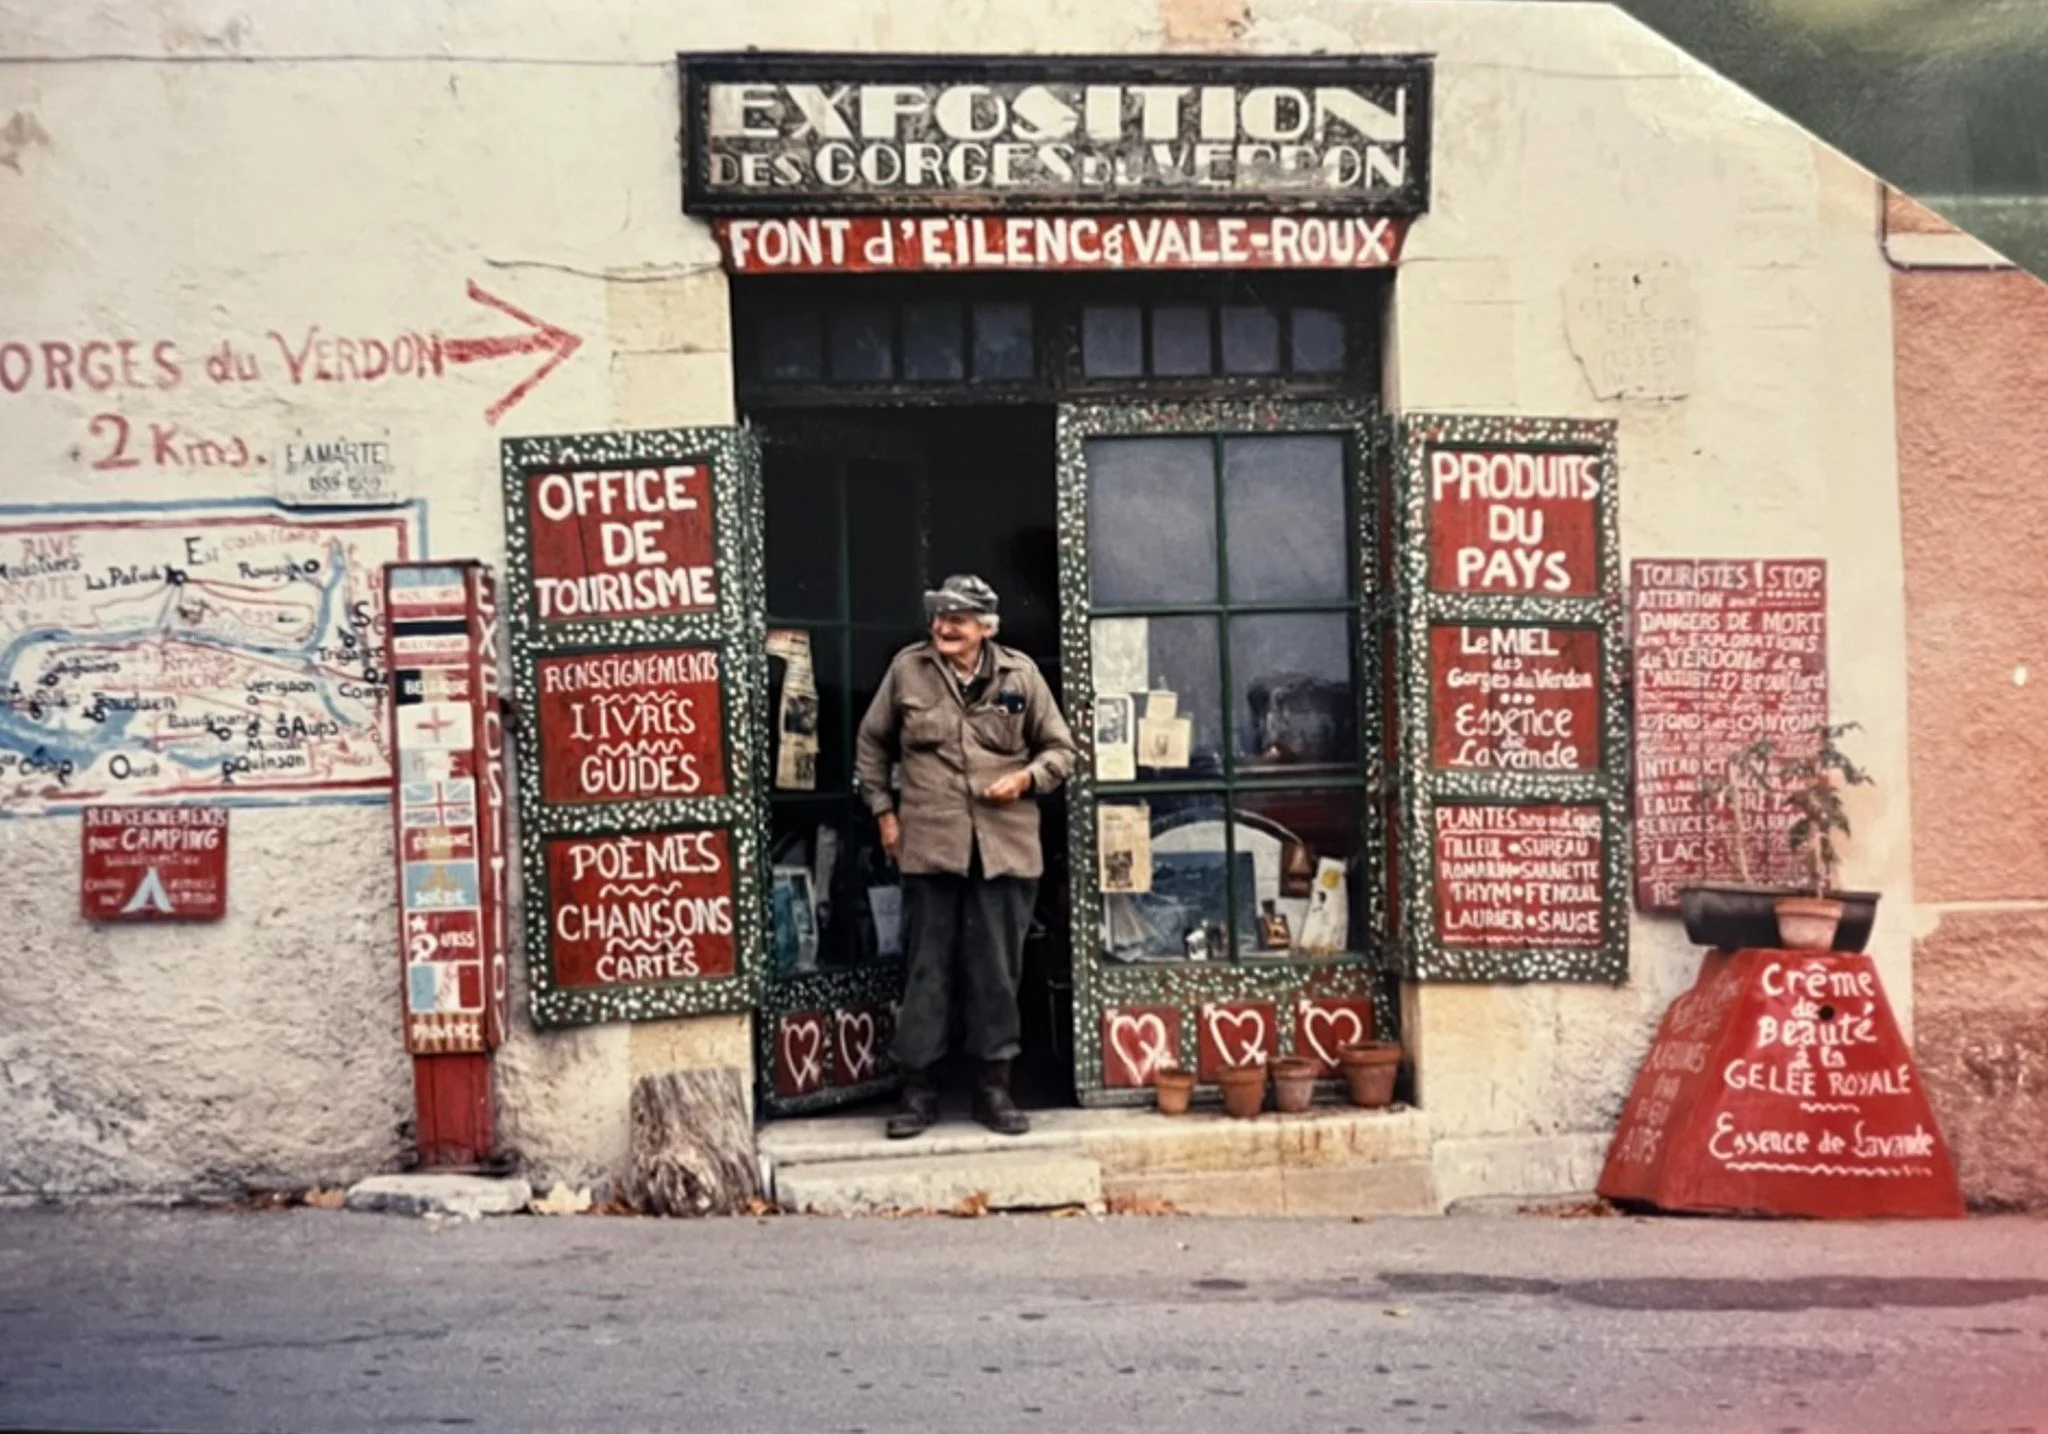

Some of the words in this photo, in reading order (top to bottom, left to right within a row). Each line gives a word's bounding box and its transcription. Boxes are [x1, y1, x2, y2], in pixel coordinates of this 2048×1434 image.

[708, 83, 1405, 142] EXPOSITION
[709, 153, 802, 187] DES
[815, 142, 1074, 188] GORGES
[729, 218, 851, 267] FONT
[1127, 217, 1391, 264] VALE-ROUX
[206, 341, 260, 385] du
[268, 325, 446, 382] VERDON
[89, 412, 141, 470] 2
[538, 466, 698, 521] OFFICE
[1431, 452, 1601, 501] PRODUITS
[601, 520, 668, 566] DE
[1488, 504, 1544, 545] DU
[1457, 546, 1571, 592] PAYS
[1636, 558, 1749, 590] TOURISTES
[1767, 565, 1823, 589] STOP
[534, 566, 717, 618] TOURISME
[1460, 626, 1488, 655] Le
[1490, 627, 1561, 656] MIEL
[1640, 612, 1721, 633] DANGERS
[1726, 613, 1750, 632] DE
[1762, 612, 1825, 635] MORT
[544, 651, 719, 692] RENSEIGNEMENTS
[1446, 667, 1510, 694] Gorges
[1532, 667, 1594, 689] Verdon
[569, 698, 696, 741] LIVRES
[1454, 703, 1574, 738] Essence
[580, 753, 701, 794] GUIDES
[1448, 739, 1580, 770] Lavande
[1435, 807, 1518, 830] PLANTES
[121, 828, 220, 852] CAMPING
[556, 895, 733, 941] CHANSONS
[1537, 910, 1601, 934] SAUGE
[596, 951, 700, 982] CARTES
[1755, 1001, 1879, 1049] Beauté
[1820, 1046, 1846, 1068] la
[1827, 1064, 1912, 1097] ROYALE
[1708, 1111, 1811, 1161] Essence
[1817, 1129, 1846, 1154] de
[1852, 1119, 1936, 1160] Lavande
